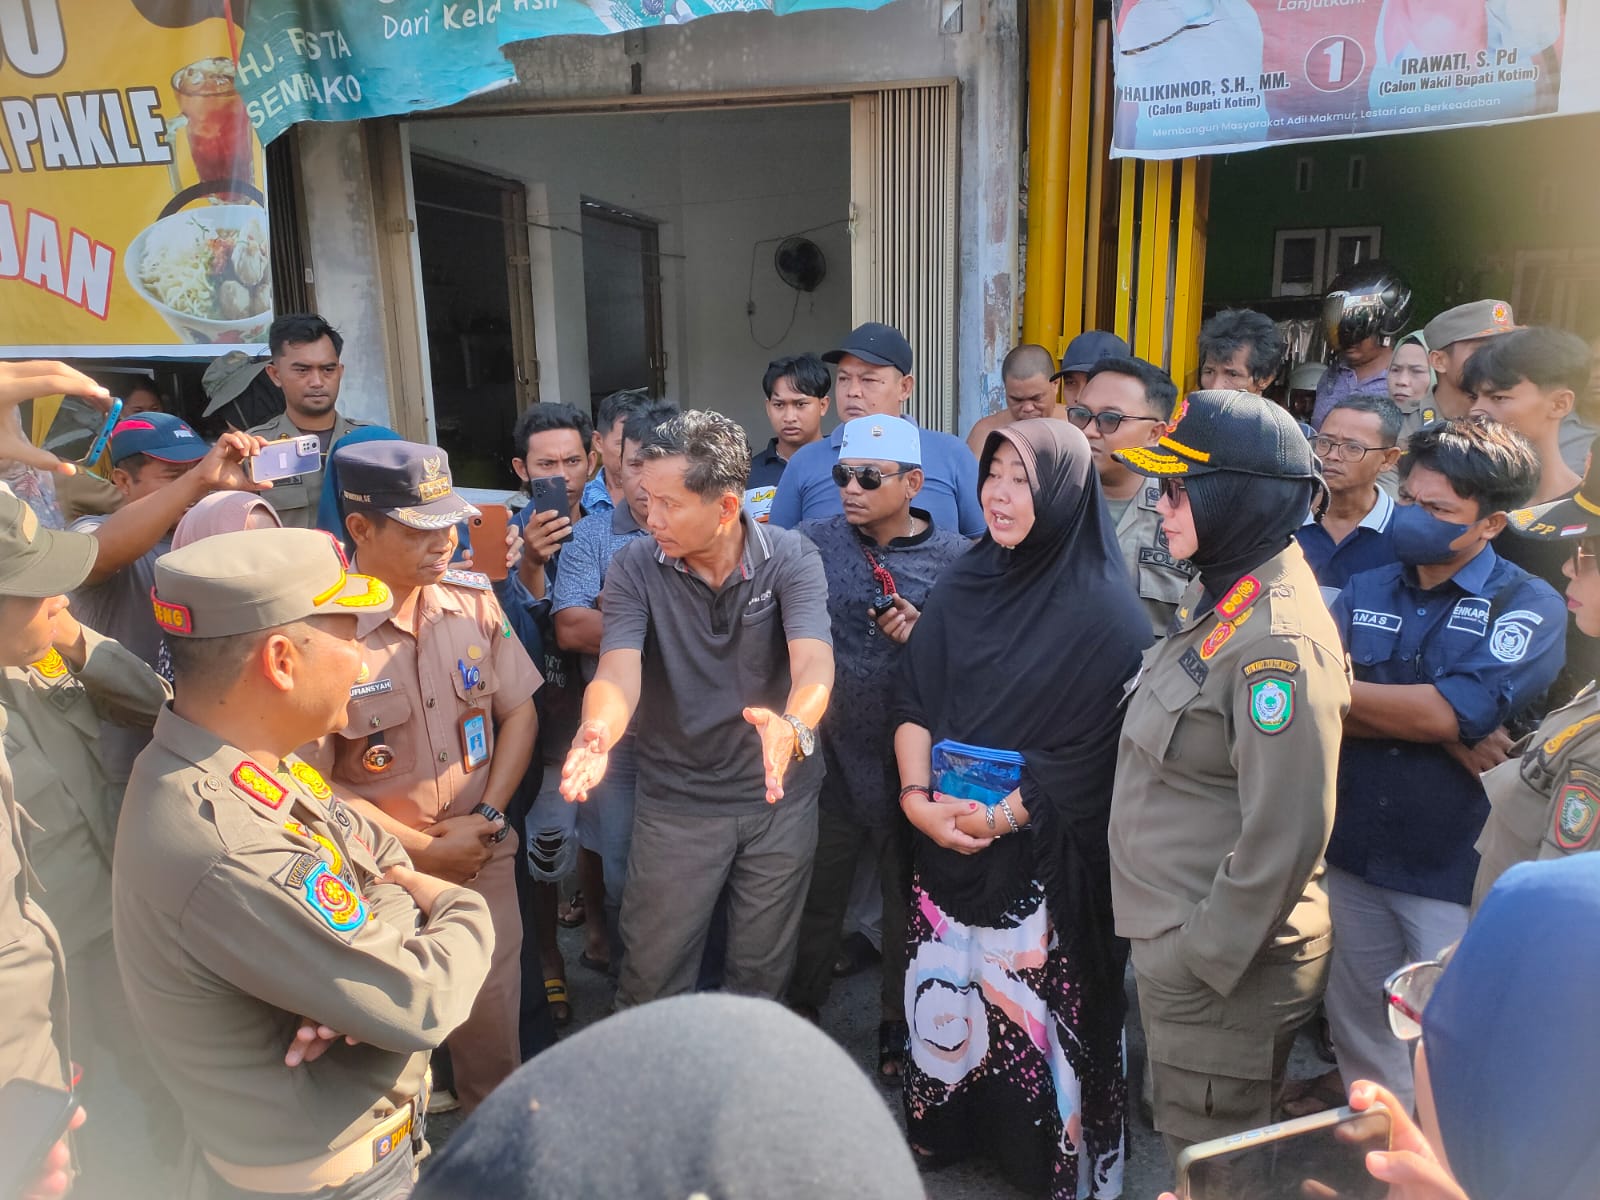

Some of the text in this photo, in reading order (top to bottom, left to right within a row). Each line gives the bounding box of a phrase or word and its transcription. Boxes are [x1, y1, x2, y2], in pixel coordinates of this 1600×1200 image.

[382, 9, 430, 39] Dari
[237, 42, 284, 86] HJ.
[1323, 40, 1346, 83] 1
[1401, 48, 1517, 75] IRAWATI, S. Pd
[1123, 80, 1216, 102] HALIKINNOR,
[1259, 72, 1290, 90] MM.
[1379, 66, 1539, 96] (Calon Wakil Bupati Kotim)
[1148, 95, 1261, 118] (Calon Bupati Kotim)
[1152, 124, 1219, 137] Membangun
[1221, 117, 1284, 132] Masyarakat
[1286, 115, 1308, 125] Adil
[1360, 105, 1397, 119] Lestari
[1399, 104, 1421, 115] dan
[1424, 97, 1501, 112] Berkeadaban
[4, 87, 172, 171] PAKLE
